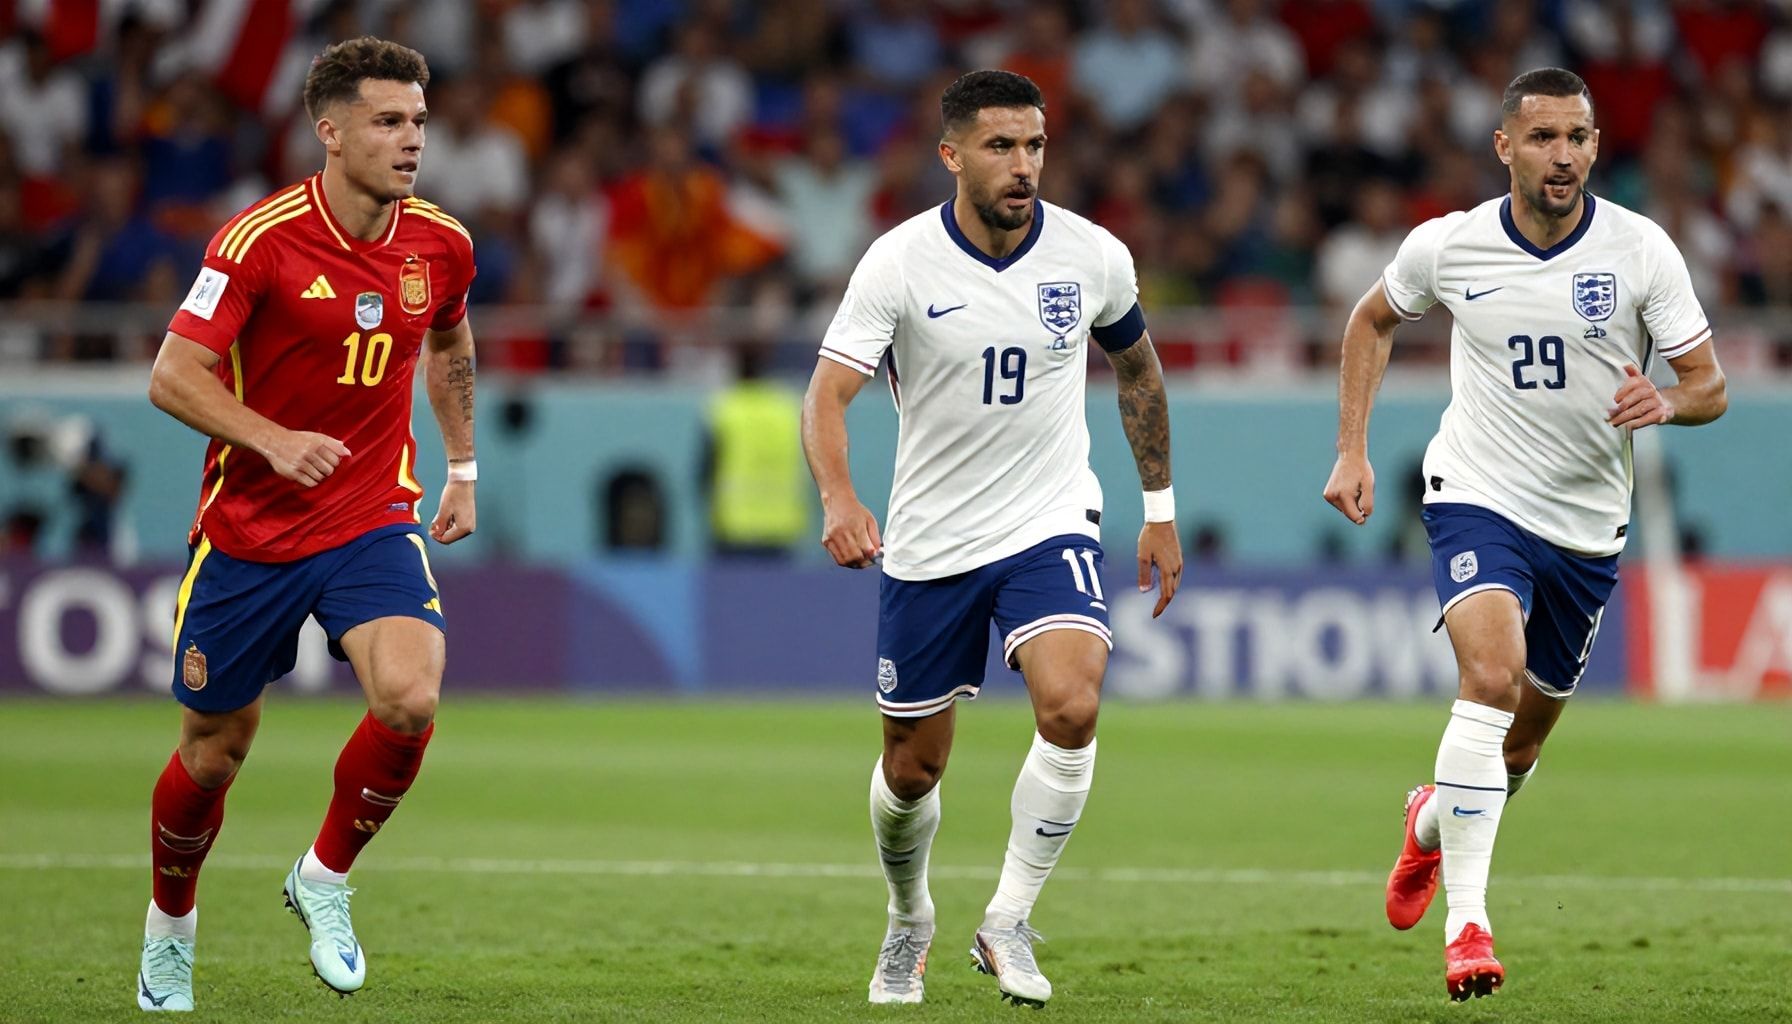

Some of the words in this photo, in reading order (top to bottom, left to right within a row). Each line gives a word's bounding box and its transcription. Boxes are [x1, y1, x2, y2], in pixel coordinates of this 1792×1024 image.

[337, 332, 393, 387] 10
[981, 346, 1027, 405] 19
[1508, 334, 1566, 390] 29
[1061, 548, 1104, 601] 11
